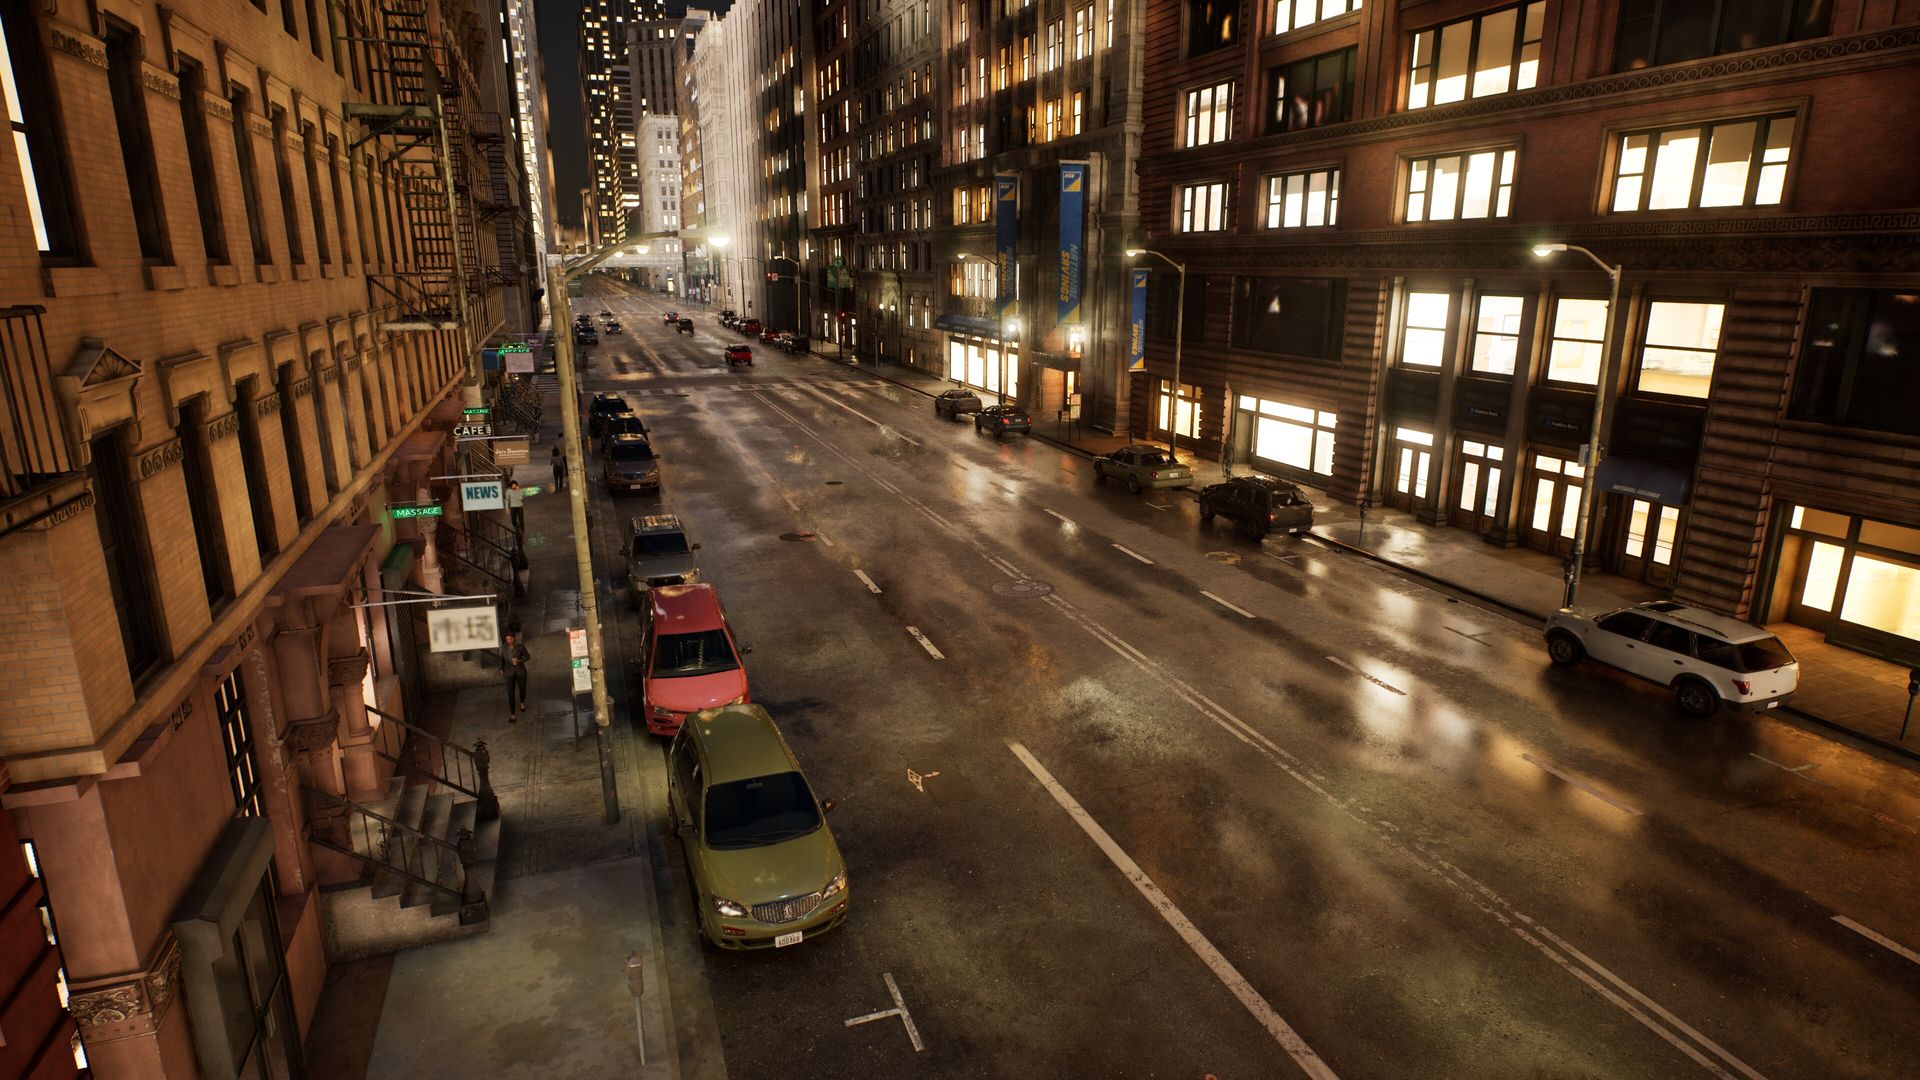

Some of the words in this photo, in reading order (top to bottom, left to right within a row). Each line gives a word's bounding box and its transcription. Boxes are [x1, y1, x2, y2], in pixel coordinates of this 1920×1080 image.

[1060, 250, 1070, 303] SAVINGS
[453, 426, 484, 436] CAFE
[466, 486, 499, 500] NEWS
[396, 508, 439, 518] MASSAGE
